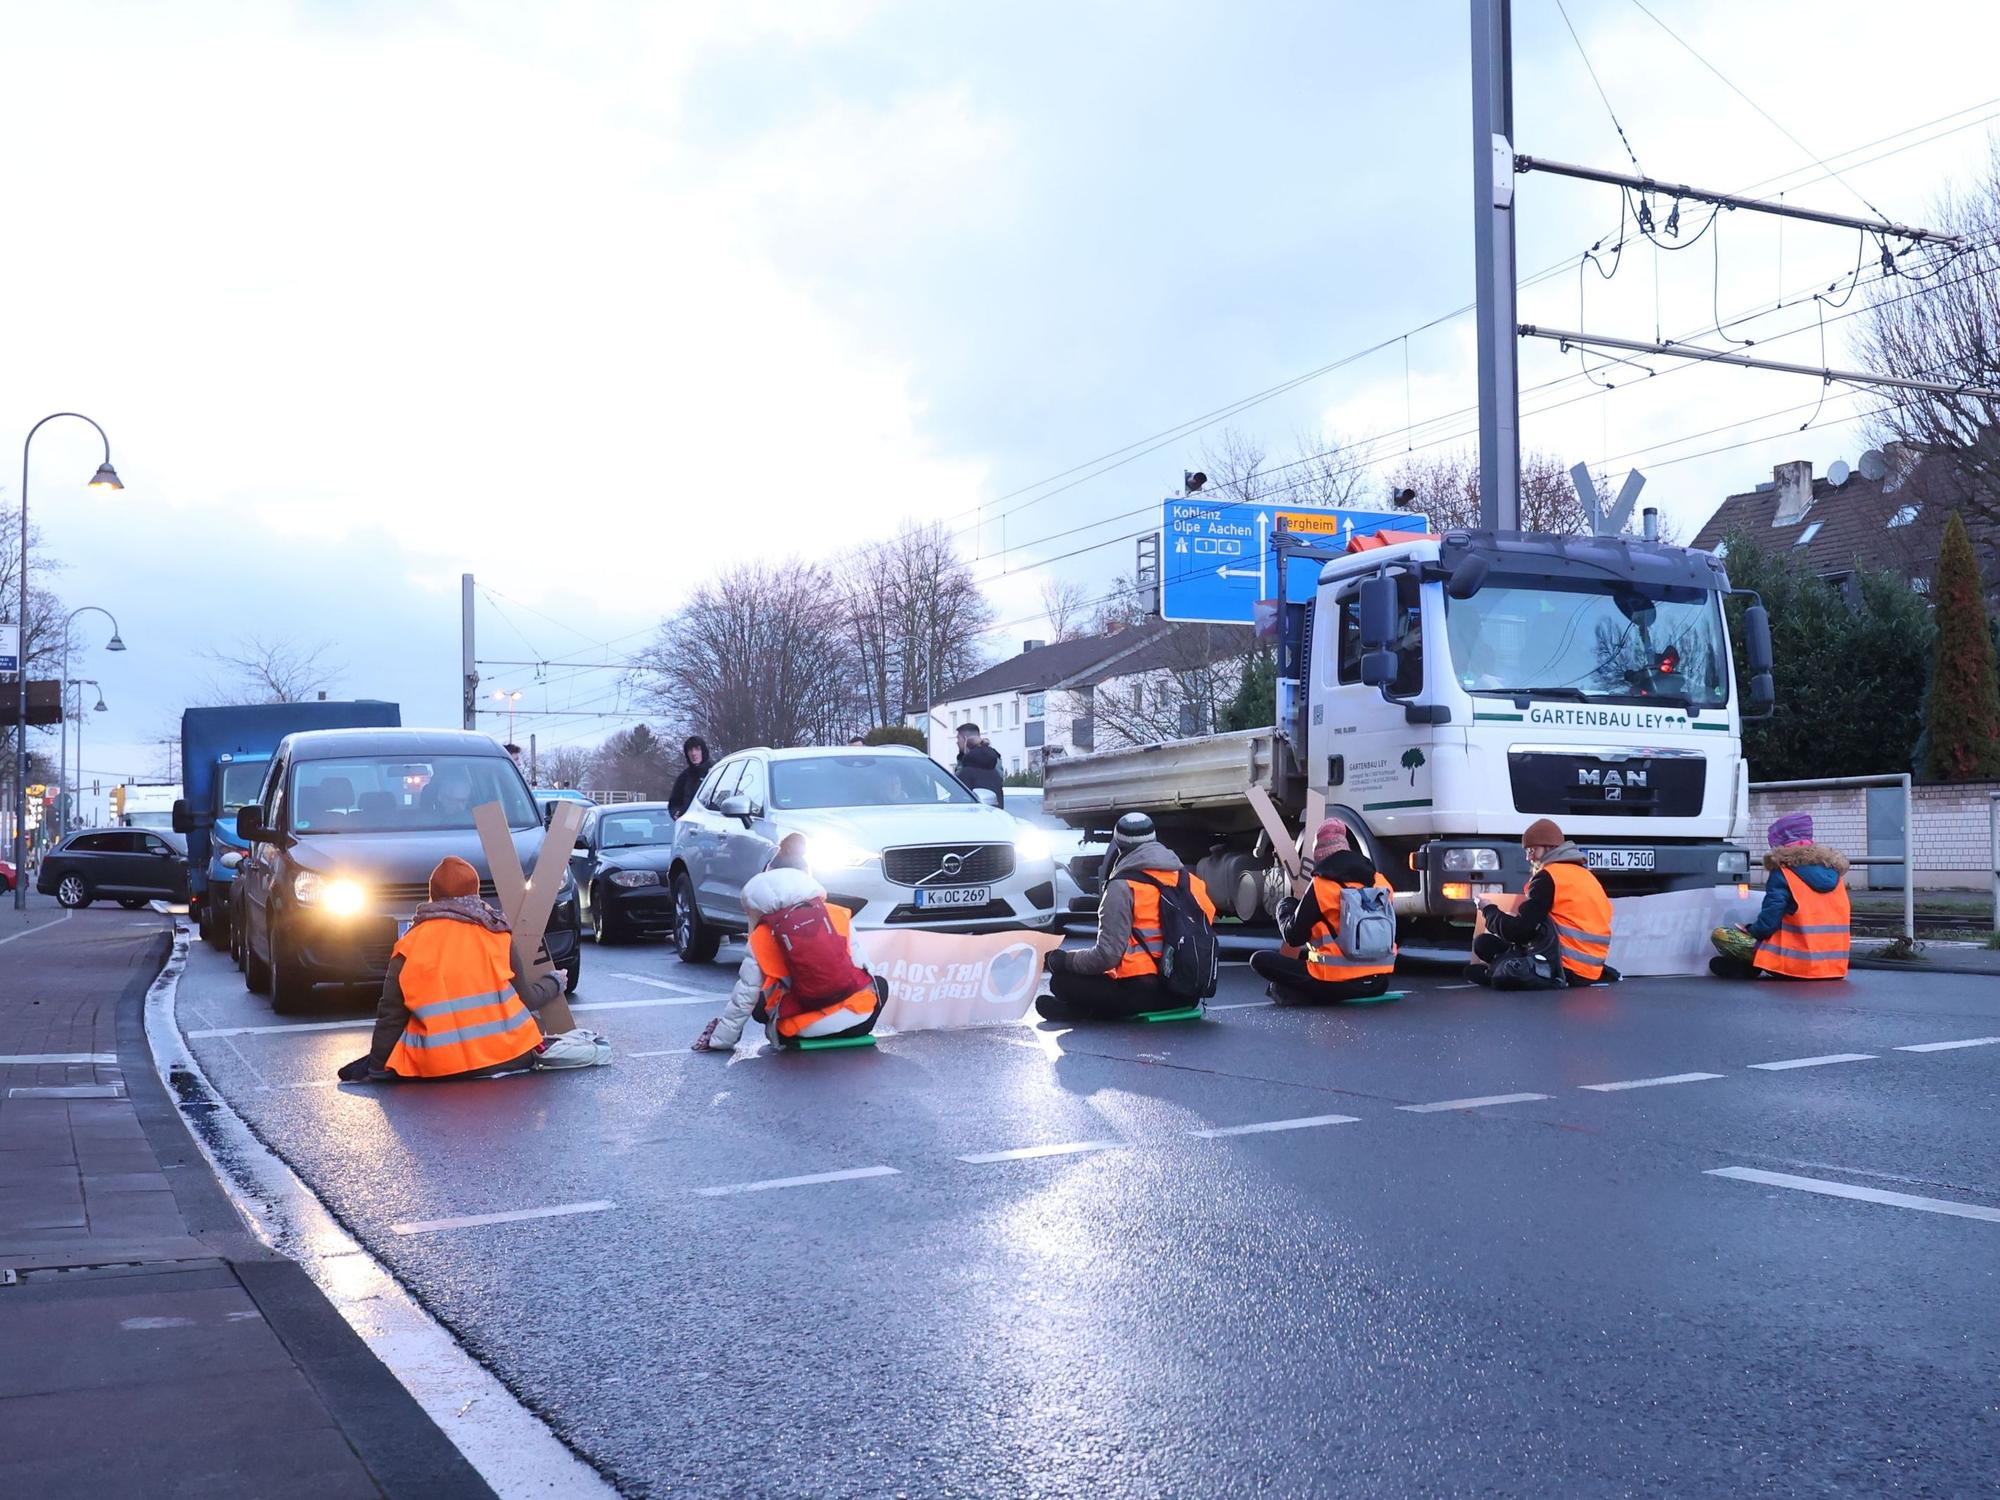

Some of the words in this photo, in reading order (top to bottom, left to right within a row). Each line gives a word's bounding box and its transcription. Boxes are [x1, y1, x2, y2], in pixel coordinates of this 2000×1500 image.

[1174, 520, 1200, 535] Olpe
[1208, 522, 1252, 536] Aachen
[1286, 517, 1334, 532] ergheim
[1531, 708, 1630, 727] GARTENBAU
[1637, 713, 1662, 728] LEY
[1578, 769, 1648, 787] MAN
[1589, 852, 1603, 866] BM
[1611, 852, 1624, 866] GL
[1627, 852, 1654, 867] 7500
[928, 892, 936, 904] K
[963, 889, 985, 902] 269
